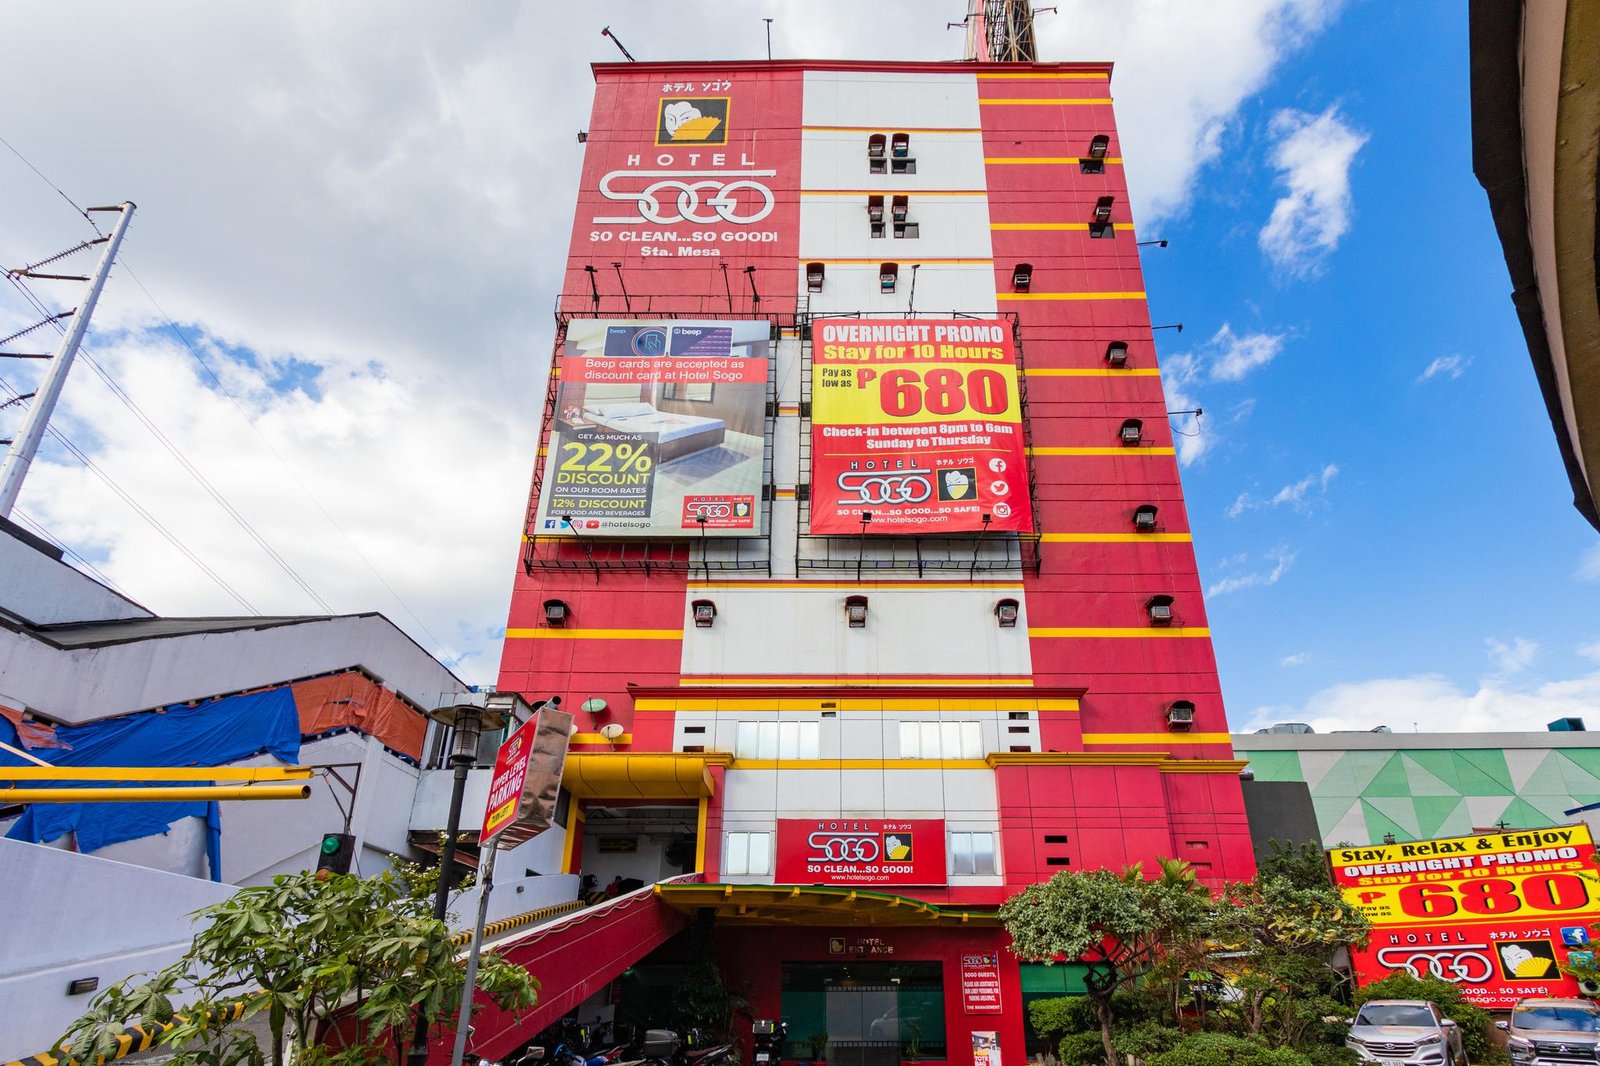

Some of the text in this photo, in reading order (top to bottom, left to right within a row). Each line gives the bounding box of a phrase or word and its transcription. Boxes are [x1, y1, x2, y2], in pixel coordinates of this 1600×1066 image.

[662, 82, 695, 92] ホテル
[627, 153, 756, 166] HOTEL
[592, 170, 776, 224] SOGO
[590, 231, 612, 242] SO
[640, 246, 720, 256] Sta. Mesa
[823, 326, 1004, 343] OVERNIGHT PROMO
[824, 345, 1004, 361] Stay for 10 Hours
[585, 359, 616, 369] Beep
[619, 359, 650, 368] cards
[654, 360, 672, 368] are
[675, 359, 728, 370] accepted
[584, 370, 743, 381] discount card at Hotel Sogo
[822, 368, 838, 378] Pay
[822, 379, 839, 388] low
[882, 426, 937, 436] between
[939, 424, 968, 434] 8pm
[970, 423, 982, 432] to
[985, 423, 1013, 434] 6am
[866, 435, 990, 449] Sunday to Thursday
[560, 442, 652, 472] 22%
[850, 460, 917, 470] HOTEL
[557, 472, 651, 485] DISCOUNT
[838, 469, 932, 504] SOGO
[552, 499, 647, 508] 12% DISCOUNT
[686, 502, 730, 518] SOGO
[510, 755, 526, 778] LEVEL
[488, 771, 523, 813] PARKING
[808, 832, 879, 862] SOGO
[1342, 830, 1573, 862] Stay, Relax & Enjoy
[1344, 847, 1578, 877] OVERNIGHT PROMO
[1358, 861, 1584, 886] Stay for 10 Hours
[1390, 932, 1465, 944] HOTEL
[1489, 931, 1517, 939] ホテル
[1377, 944, 1493, 983] SOGO
